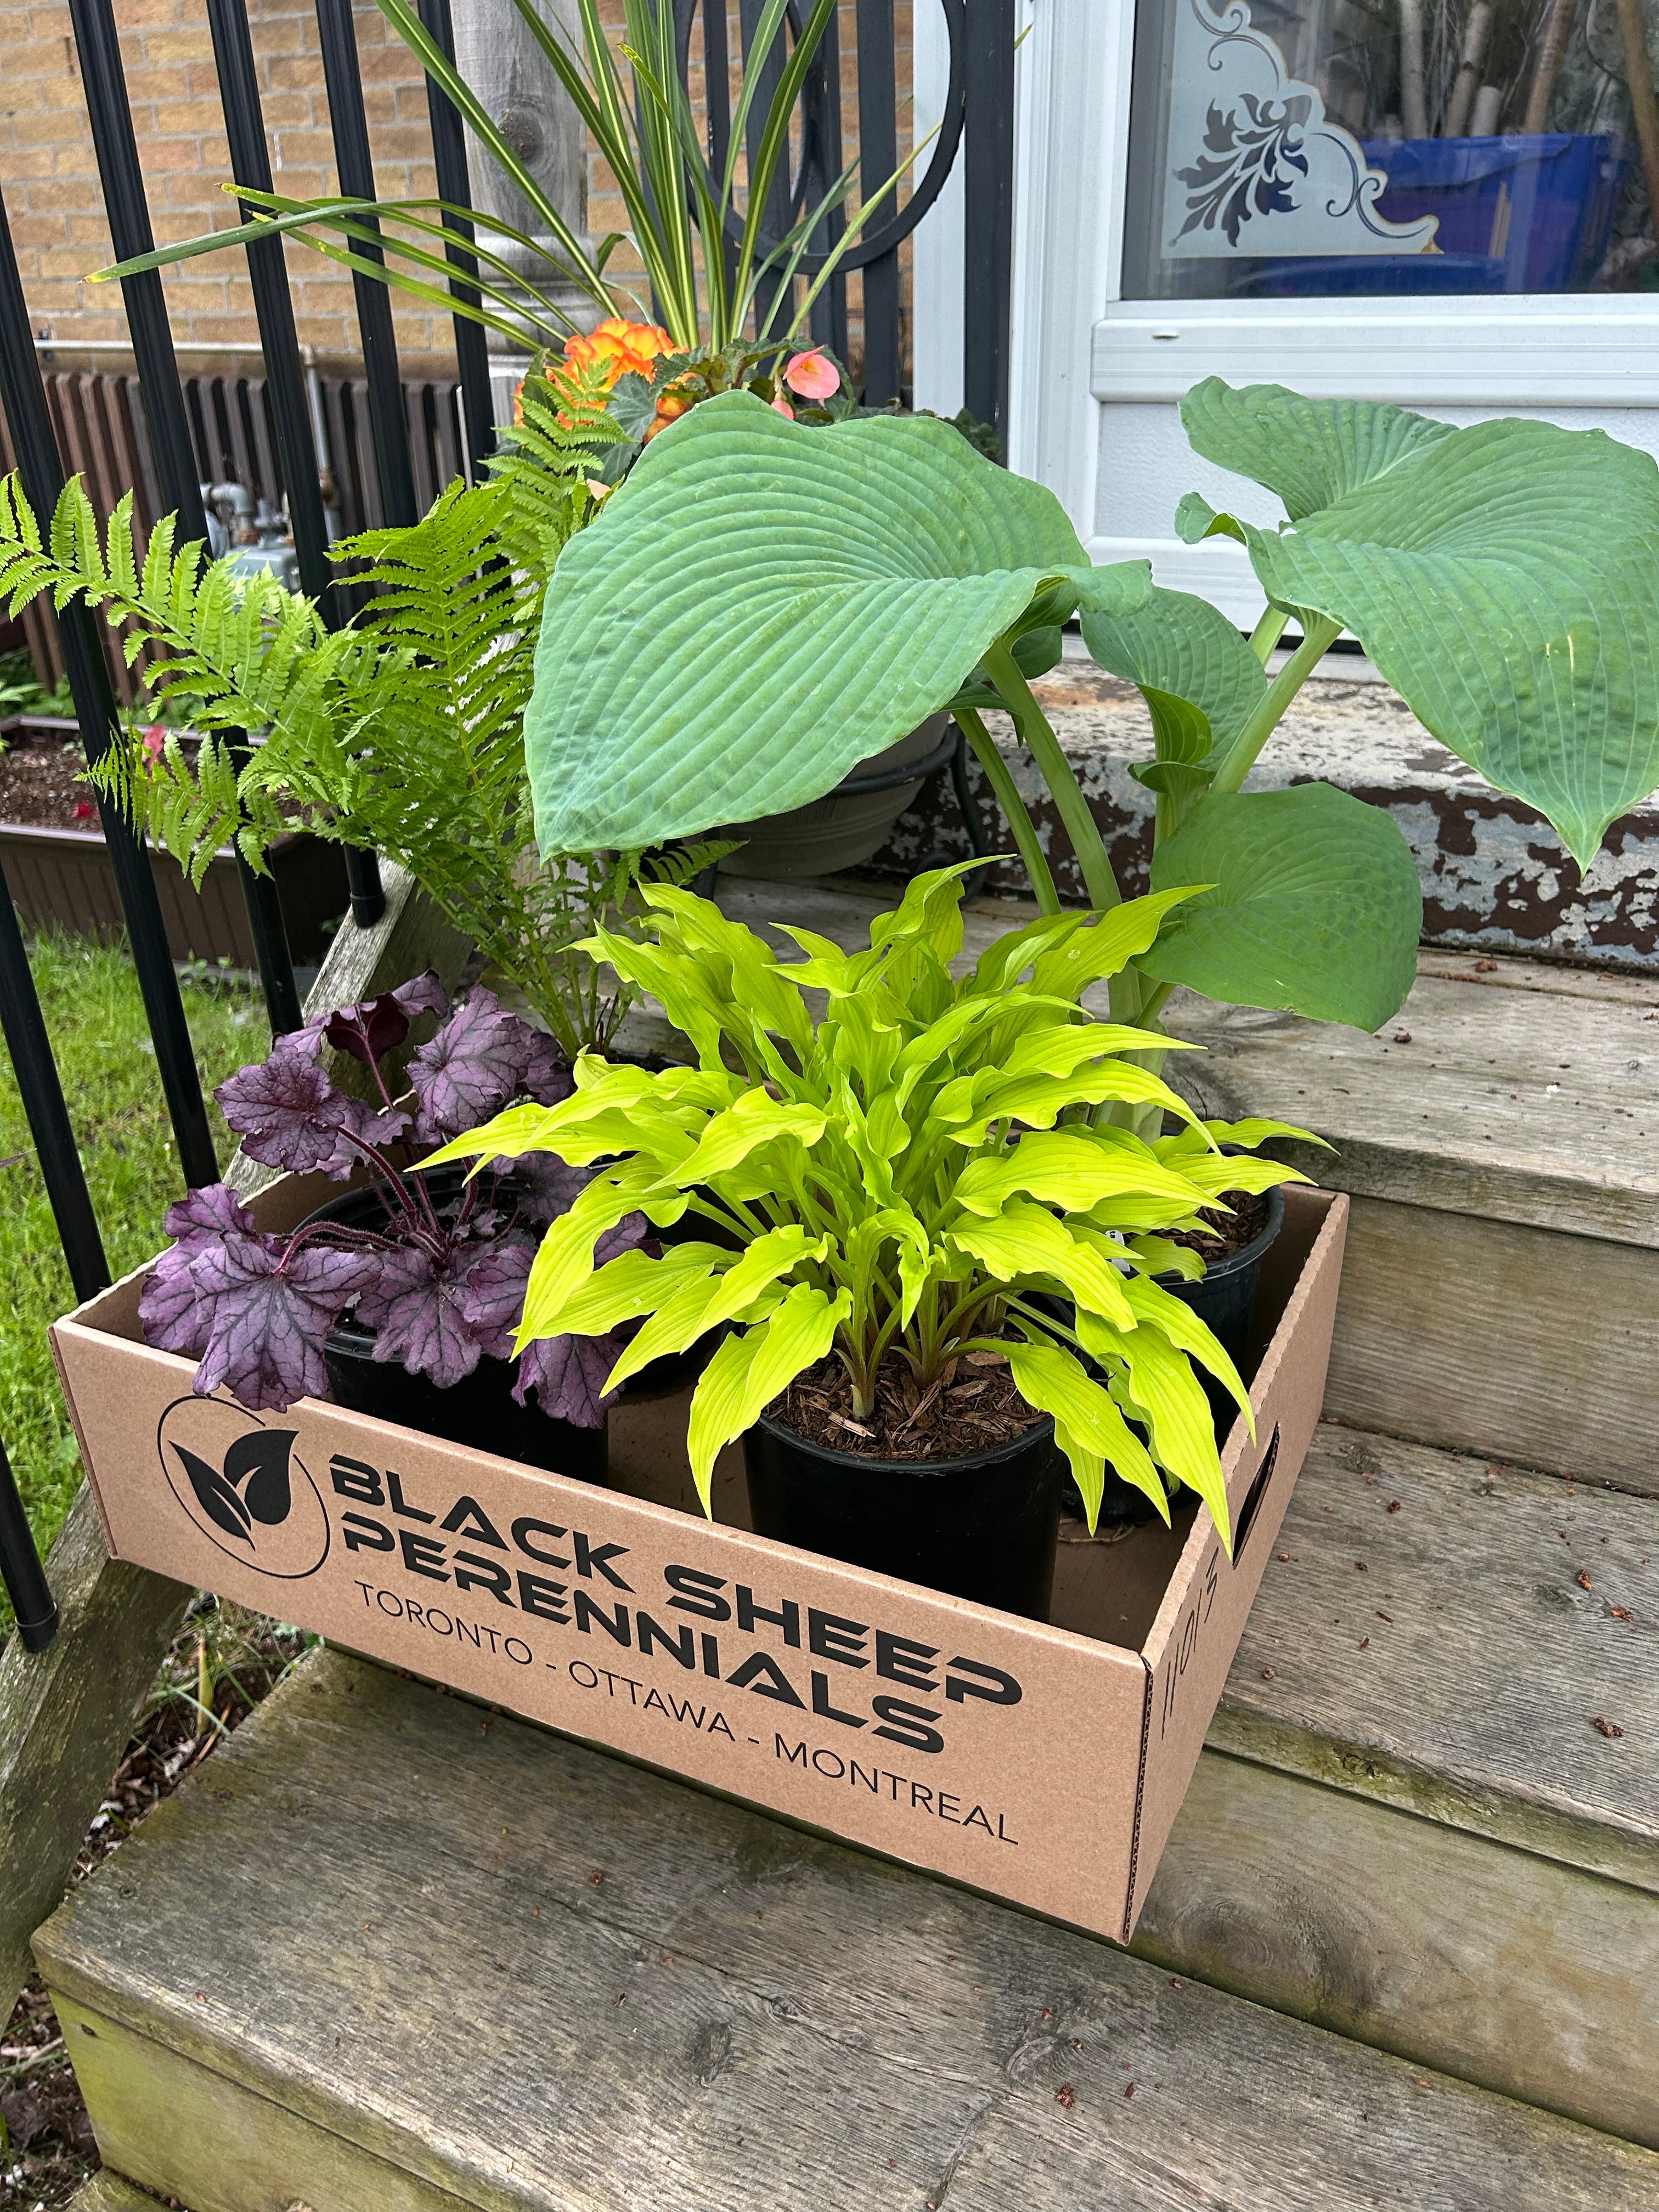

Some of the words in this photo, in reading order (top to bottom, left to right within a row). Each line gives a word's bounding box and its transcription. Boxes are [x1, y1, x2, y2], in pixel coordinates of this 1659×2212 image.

[328, 1453, 637, 1594] BLACK
[664, 1564, 1023, 1706] SHEEP
[340, 1510, 945, 1754] PERENNIALS
[353, 1579, 533, 1666] TORONTO
[568, 1660, 737, 1743] OTTAWA
[774, 1732, 1020, 1846] MONTREAL
